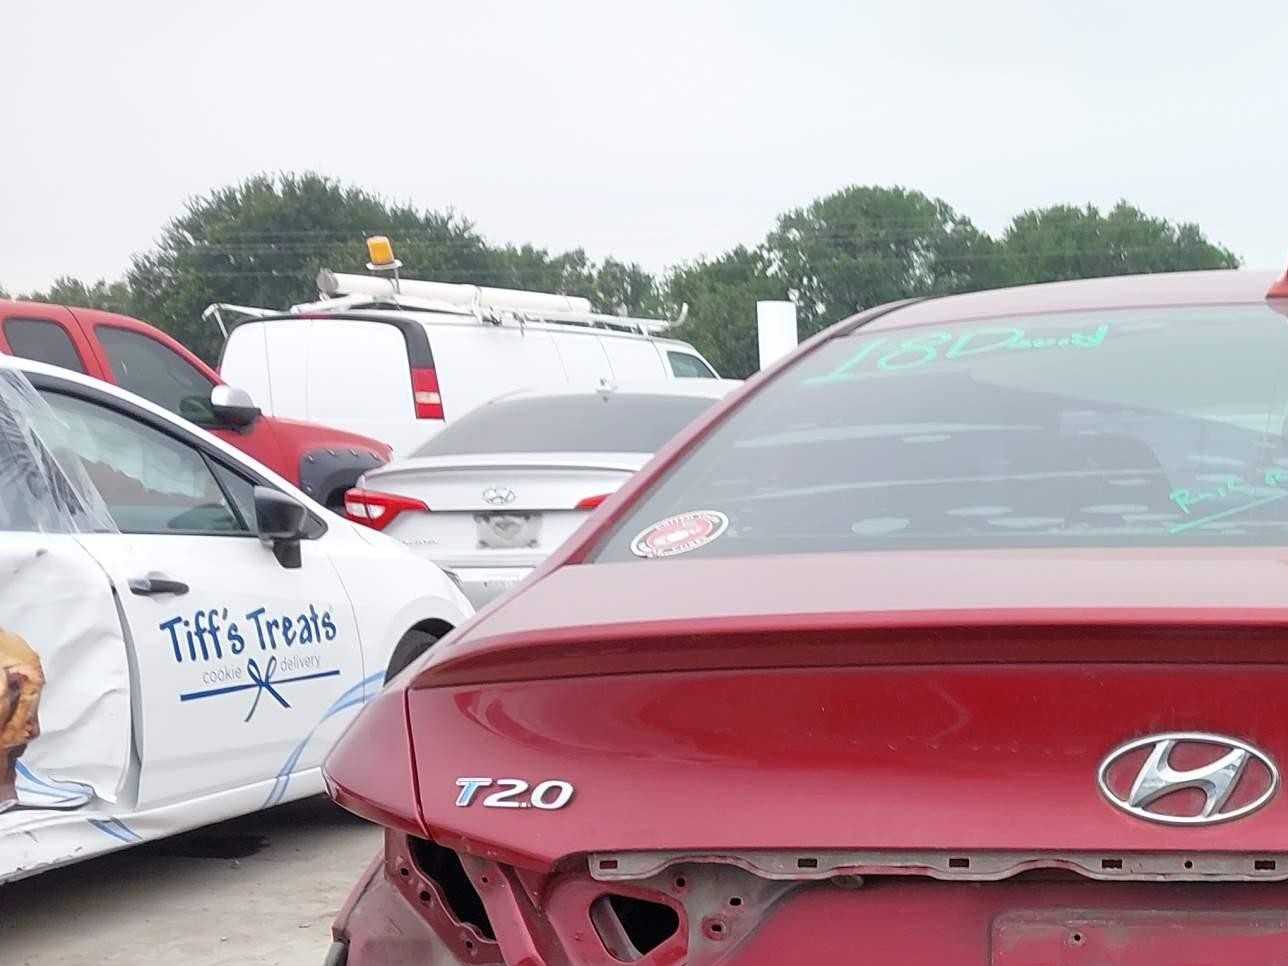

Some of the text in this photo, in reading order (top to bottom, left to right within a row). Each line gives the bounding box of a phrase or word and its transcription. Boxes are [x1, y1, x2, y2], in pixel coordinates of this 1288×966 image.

[159, 603, 338, 663] Tiff's Treats
[202, 654, 321, 685] cookie delivery
[455, 777, 575, 810] T2.0
